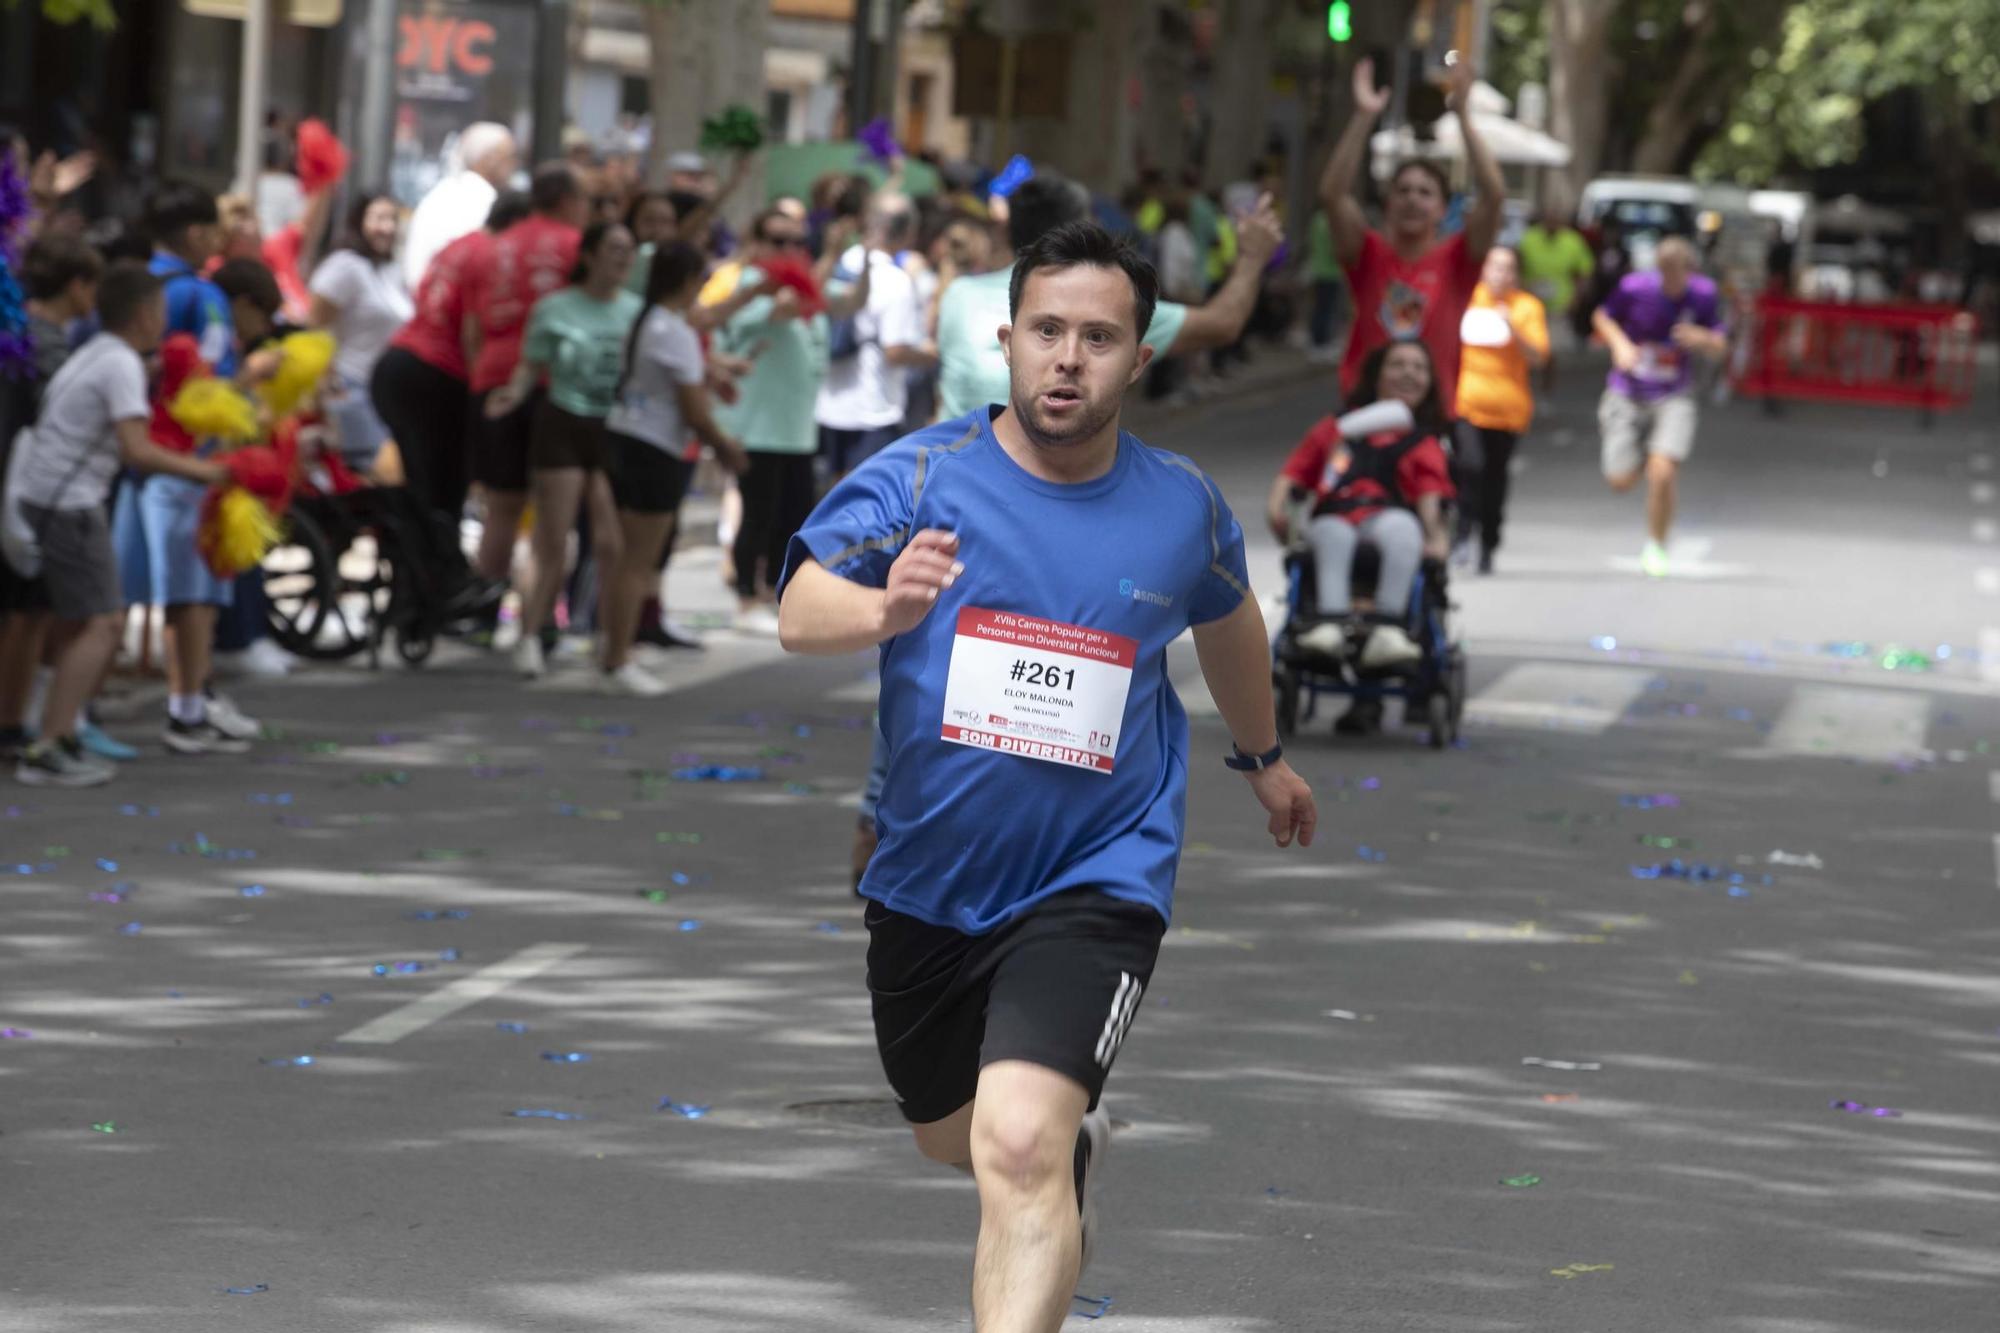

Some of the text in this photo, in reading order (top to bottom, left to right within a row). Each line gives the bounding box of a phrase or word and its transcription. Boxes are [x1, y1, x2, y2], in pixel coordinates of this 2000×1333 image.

[976, 624, 1119, 660] Persones amb Diversitat Funcional
[1018, 618, 1050, 633] Carrera
[1051, 624, 1085, 639] Popular
[1086, 631, 1101, 644] per
[1102, 636, 1108, 645] a
[1010, 659, 1076, 692] #261
[1004, 688, 1075, 708] ELOY MALONDA
[959, 729, 996, 748] SOM
[1000, 737, 1100, 767] DIVERSITAT
